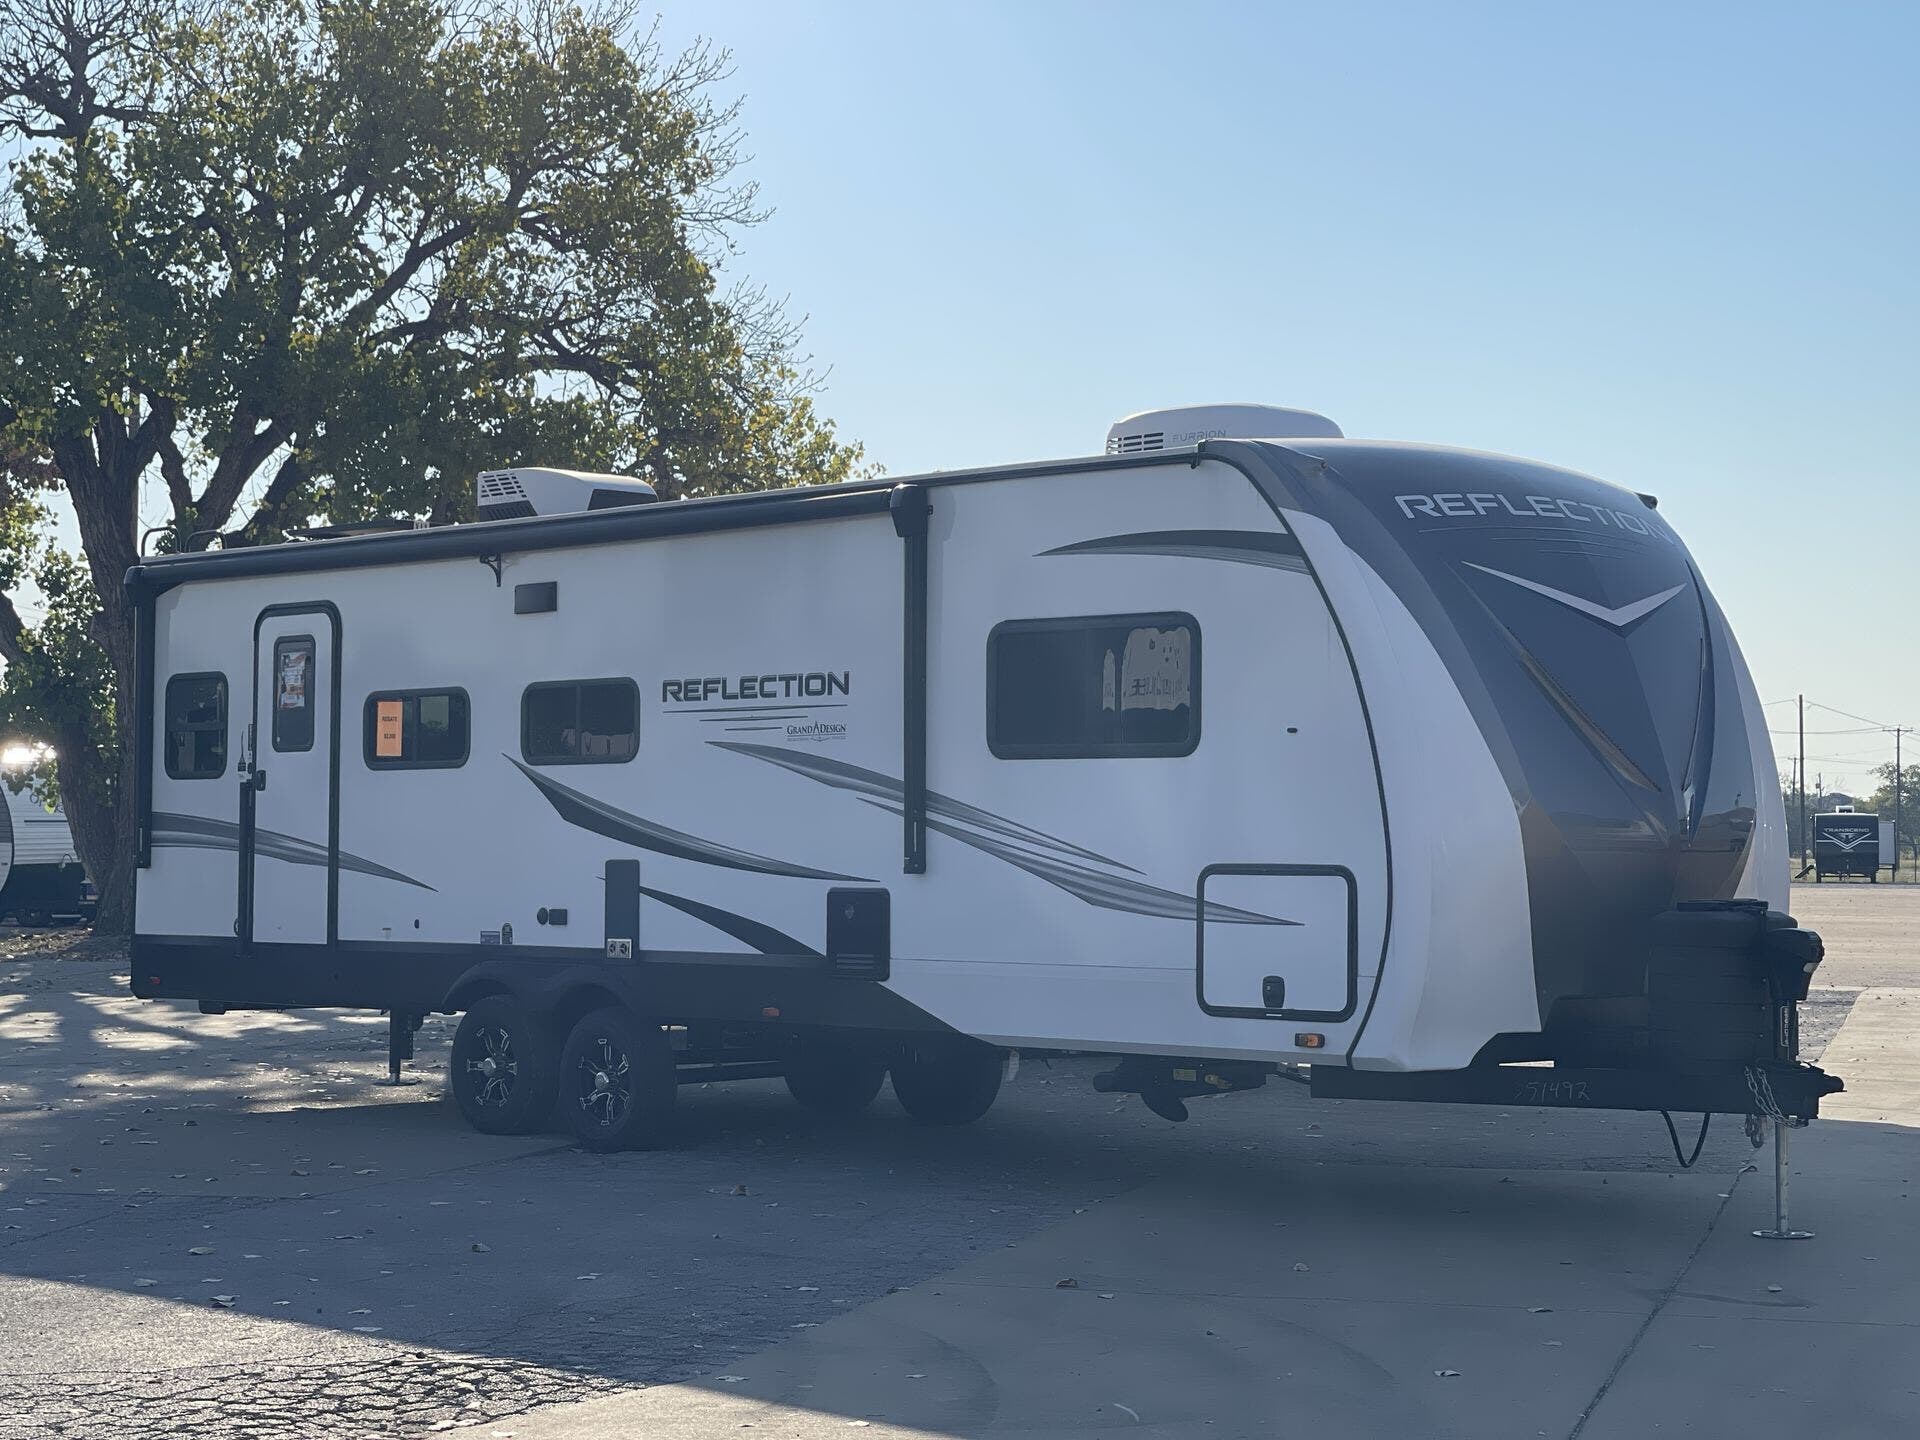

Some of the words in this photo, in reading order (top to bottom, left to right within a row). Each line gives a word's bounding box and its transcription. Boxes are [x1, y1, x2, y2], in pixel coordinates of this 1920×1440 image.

[1172, 430, 1227, 443] FURRION
[1394, 493, 1676, 545] REFLECTION
[662, 671, 850, 703] REFLECTION
[786, 724, 813, 735] GRAND
[820, 722, 846, 733] DESIGN
